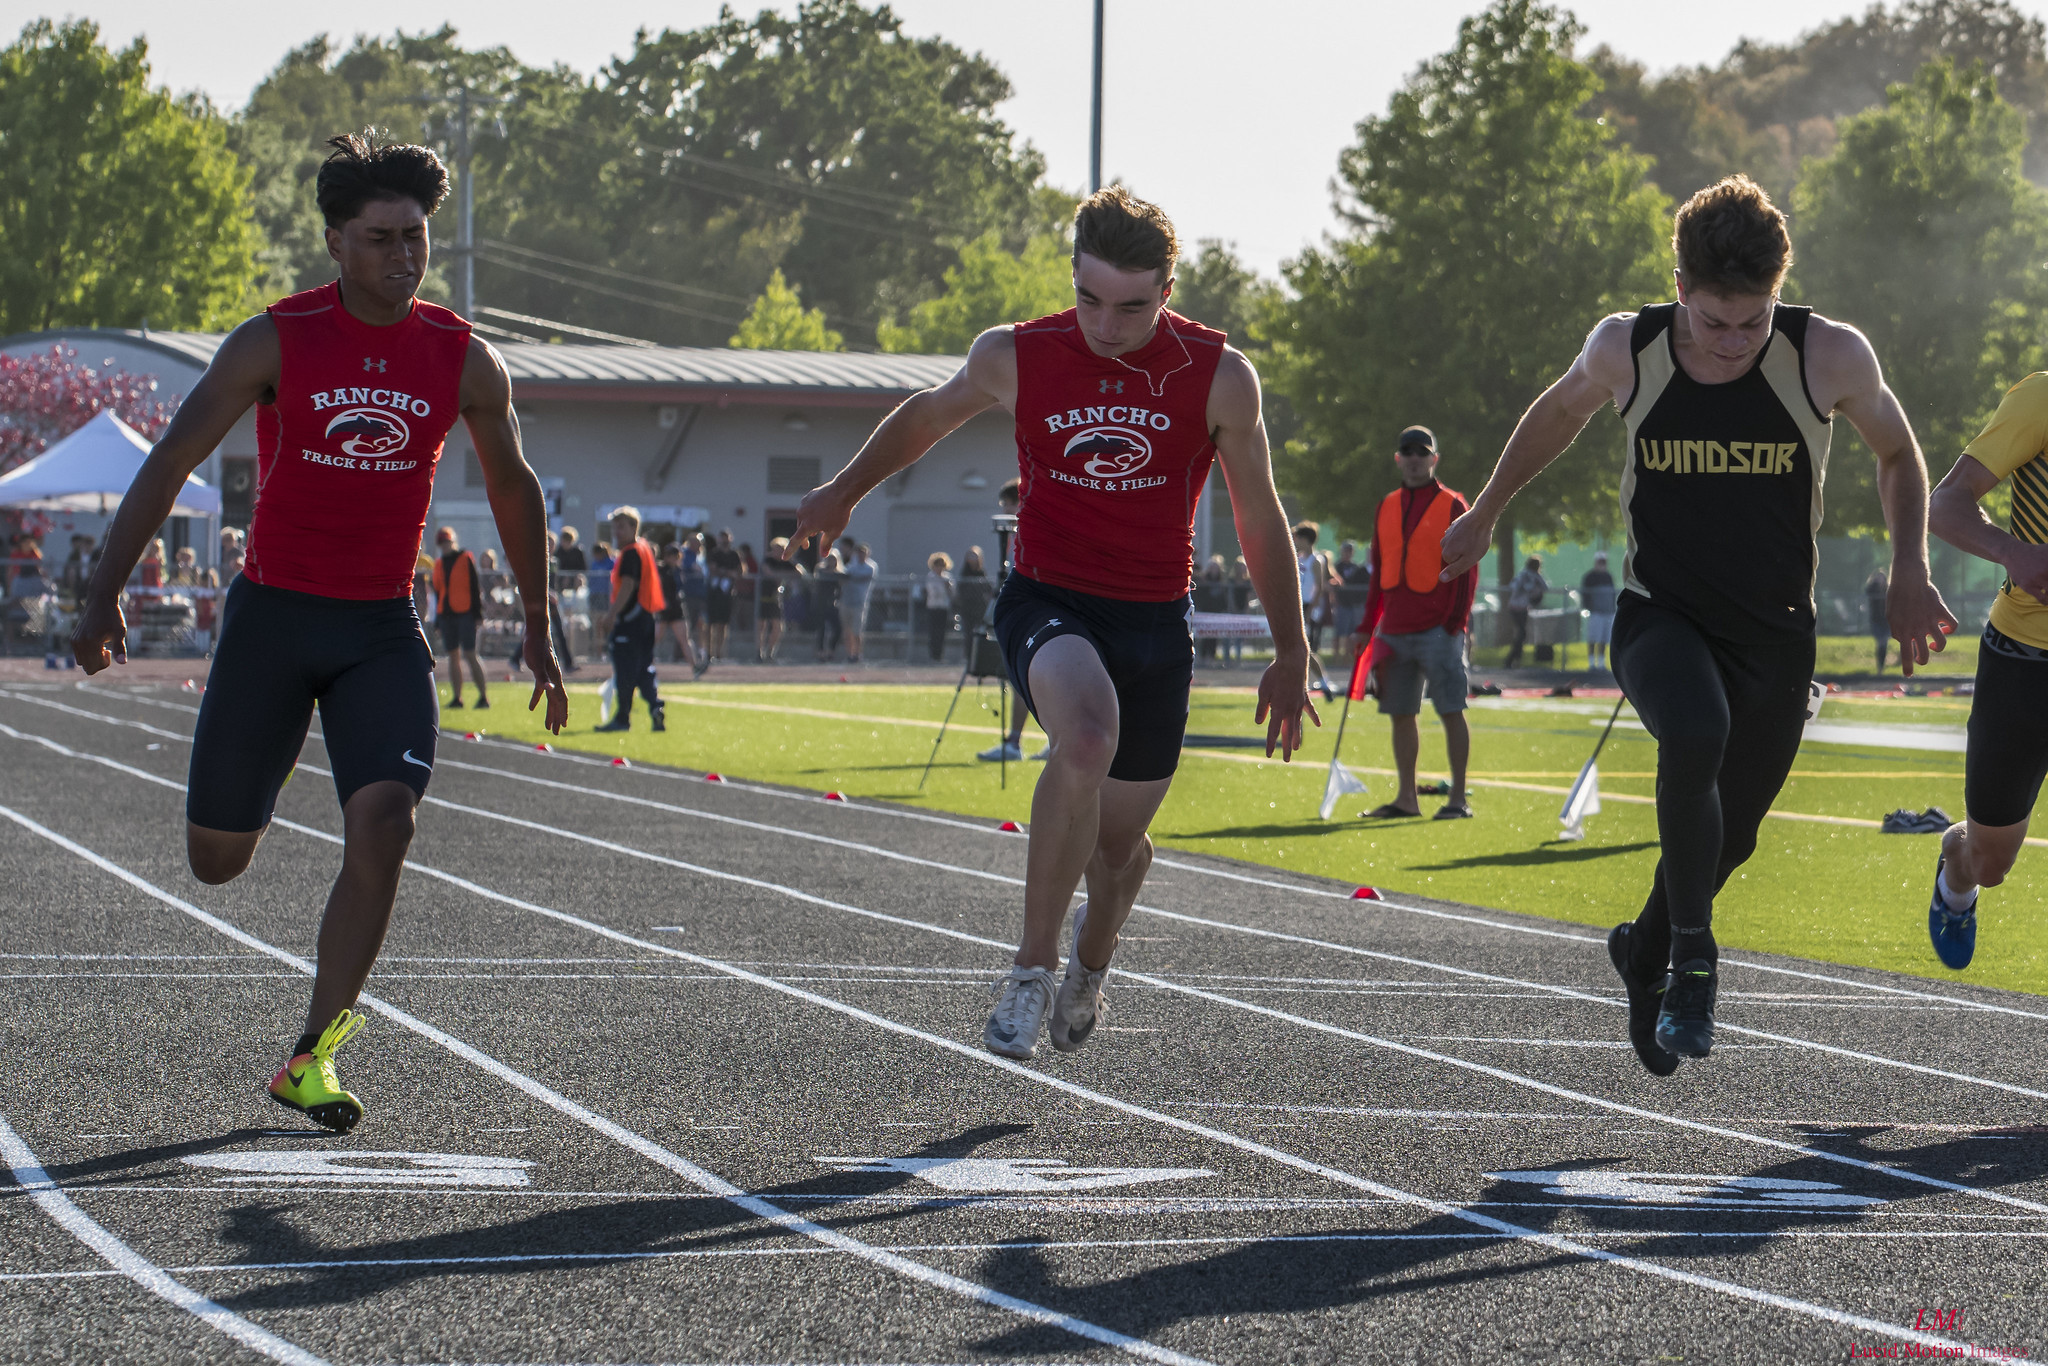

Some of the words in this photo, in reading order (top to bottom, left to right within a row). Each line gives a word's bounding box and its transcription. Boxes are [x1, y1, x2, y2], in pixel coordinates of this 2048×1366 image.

[310, 387, 431, 418] RANCHO
[1044, 406, 1171, 434] RANCHO
[302, 449, 356, 470] TRACK
[359, 459, 371, 471] &
[374, 460, 417, 471] FIELD
[1639, 438, 1799, 475] WINDSOR
[1049, 469, 1101, 491] TRACK
[1105, 480, 1117, 491] &
[1121, 475, 1167, 491] FIELD
